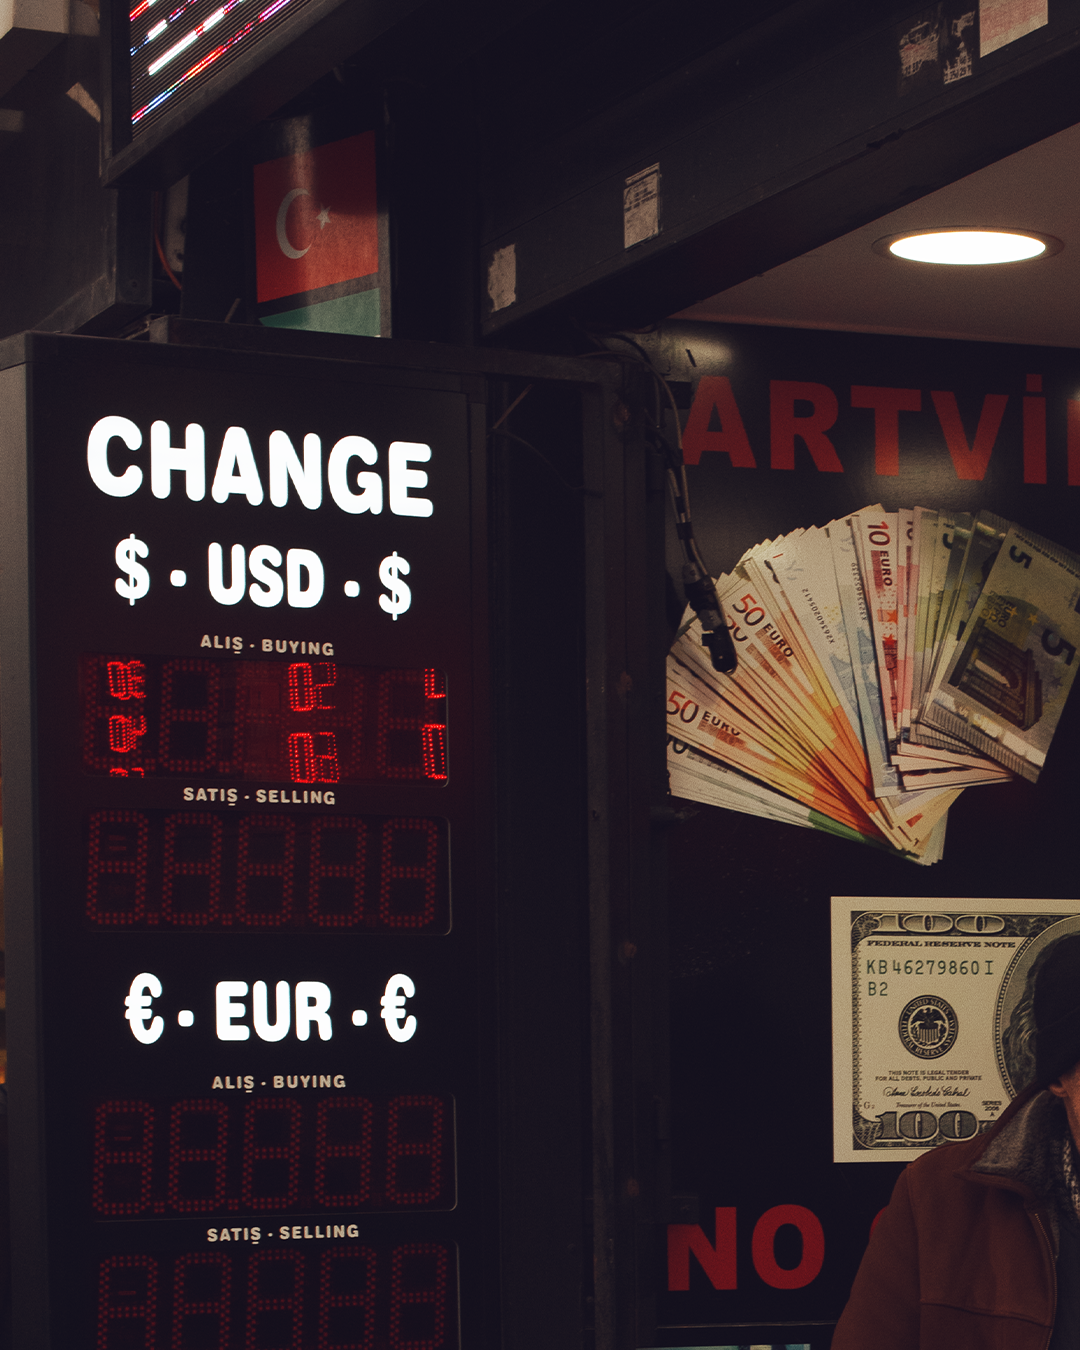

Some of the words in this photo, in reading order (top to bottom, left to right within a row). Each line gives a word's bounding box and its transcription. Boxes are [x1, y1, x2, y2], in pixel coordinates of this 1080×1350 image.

[86, 415, 434, 518] CHANGE
[868, 521, 890, 546] 10
[880, 551, 893, 586] EURO
[1009, 545, 1033, 569] 5
[114, 532, 150, 606] $
[207, 542, 325, 609] USD
[378, 550, 412, 621] $
[732, 594, 765, 626] 50
[200, 635, 244, 655] ALIŞ
[261, 638, 335, 657] BUYING
[763, 623, 794, 658] EURO
[1041, 628, 1077, 666] 5
[666, 690, 699, 724] 50
[183, 787, 238, 806] SATIŞ
[256, 790, 335, 806] SELLING
[871, 913, 1006, 934] 100
[925, 940, 981, 948] RESERVE
[866, 960, 888, 975] KB
[892, 960, 980, 975] 46279860
[868, 981, 888, 996] B2
[124, 972, 164, 1045] €
[215, 980, 333, 1043] EUR
[380, 973, 417, 1043] €
[212, 1075, 255, 1093] ALIŞ
[273, 1074, 346, 1089] BUYING
[875, 1110, 980, 1142] 100
[207, 1227, 261, 1244] SATIŞ
[279, 1225, 359, 1241] SELLING
[667, 1204, 825, 1291] NO
